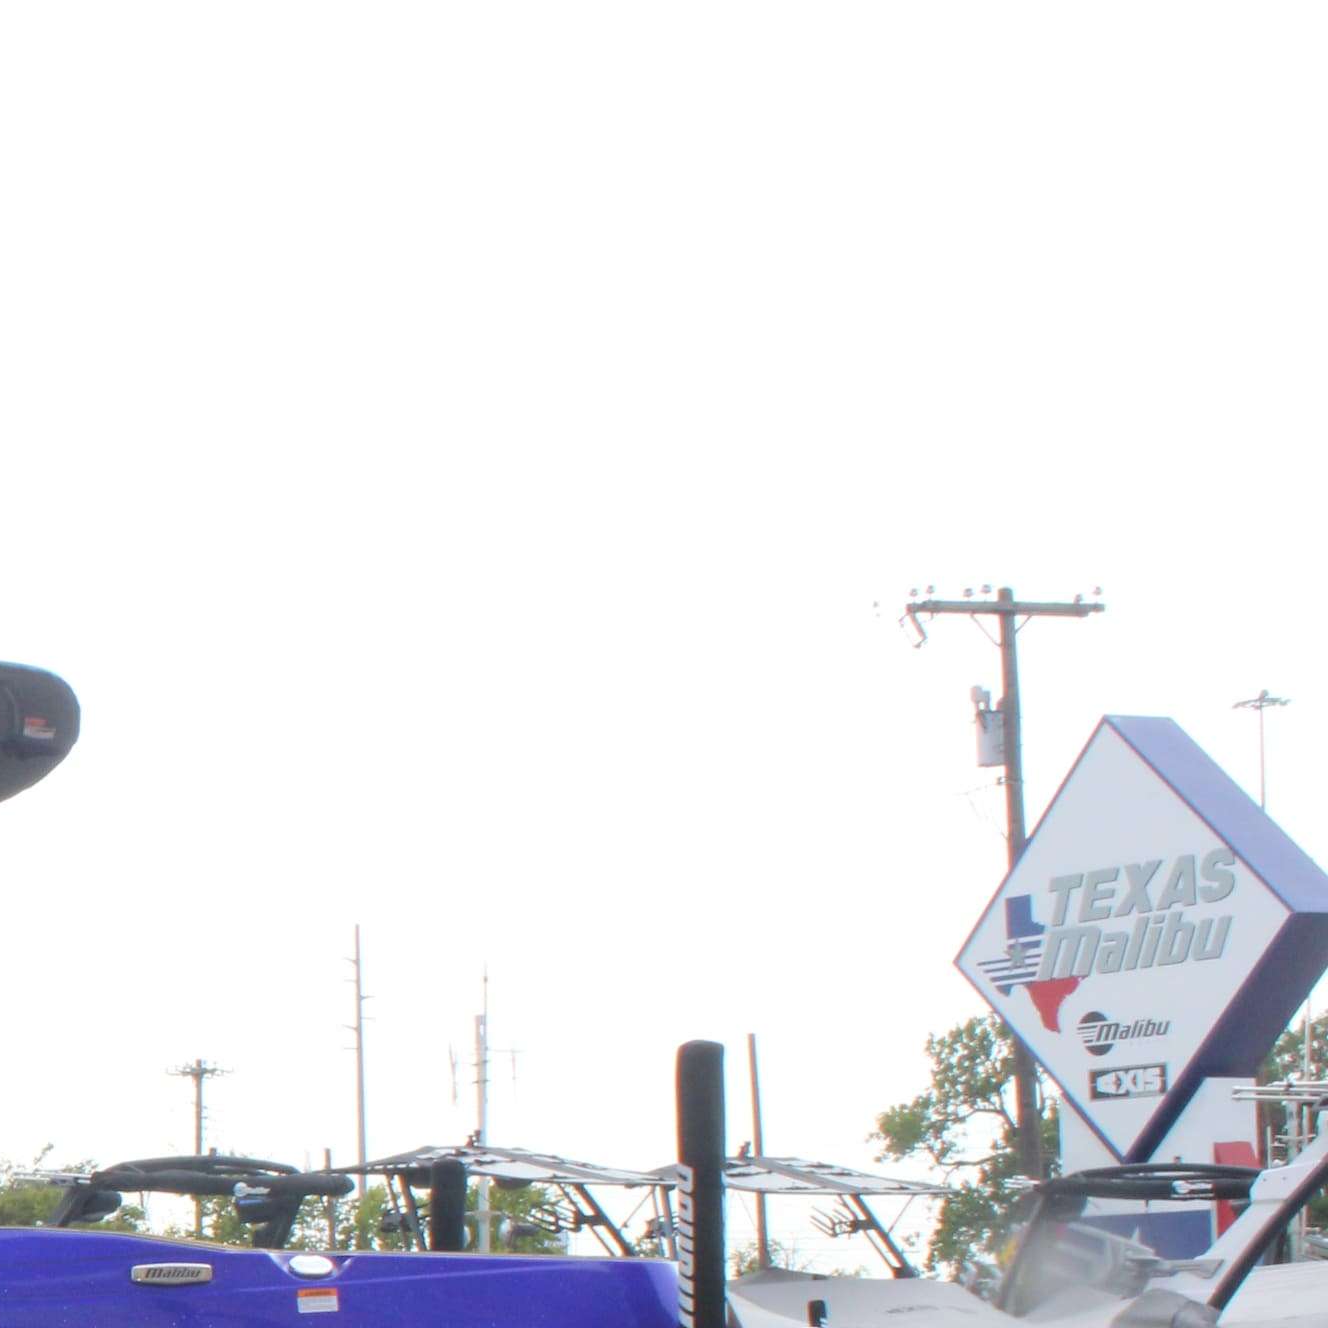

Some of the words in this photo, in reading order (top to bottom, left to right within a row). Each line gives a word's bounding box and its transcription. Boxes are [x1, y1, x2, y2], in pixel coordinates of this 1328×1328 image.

[1048, 848, 1237, 928] TEXAS
[1038, 914, 1234, 981] Malibu
[1095, 1017, 1172, 1044] Malibu
